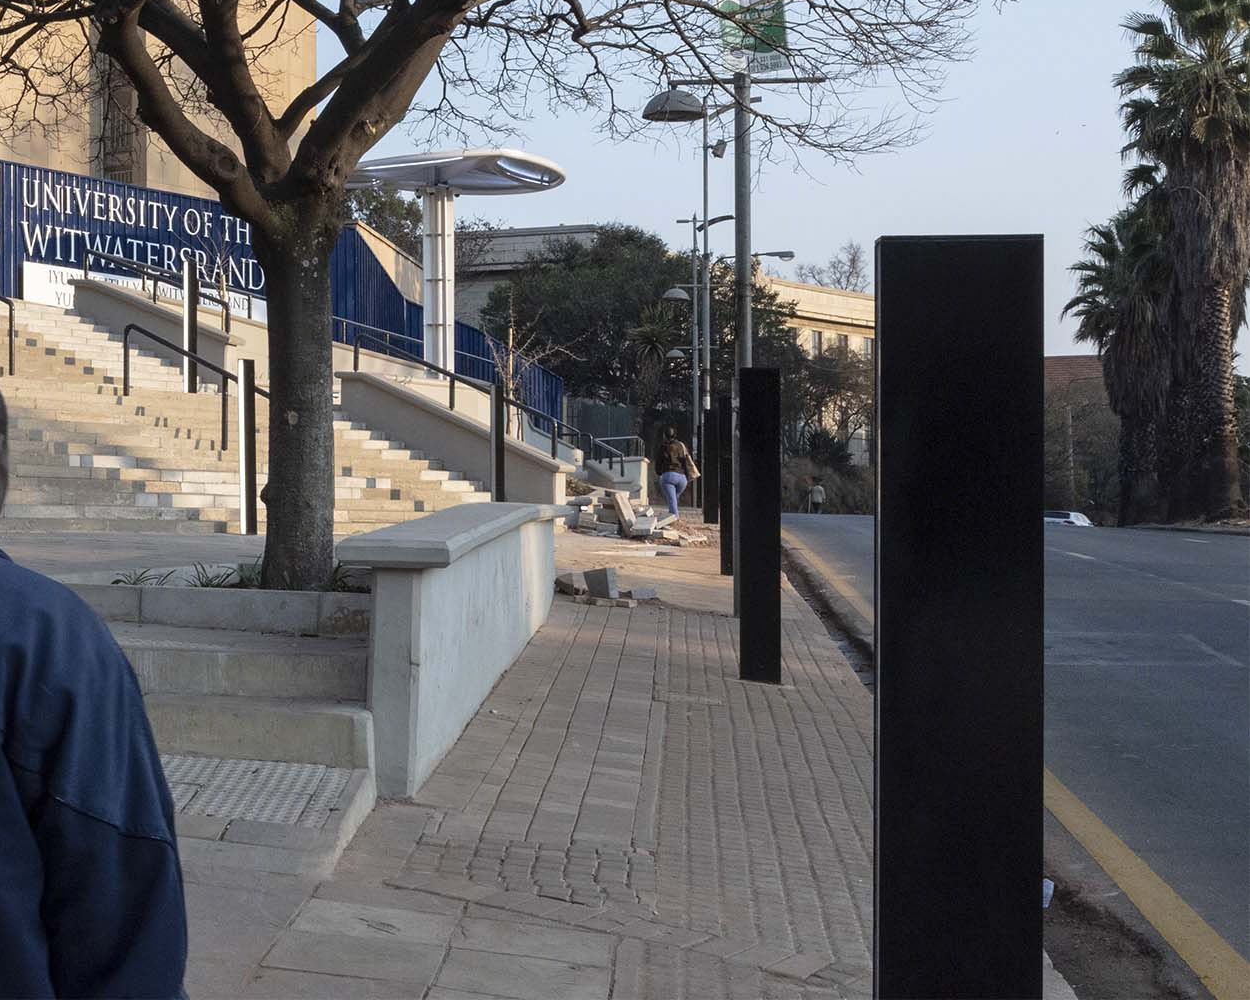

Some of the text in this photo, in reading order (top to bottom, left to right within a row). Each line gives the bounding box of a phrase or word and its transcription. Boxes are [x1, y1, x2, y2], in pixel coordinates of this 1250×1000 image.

[22, 177, 251, 245] UNIVERSITY OF TH
[21, 221, 265, 290] WITWATERSRAND
